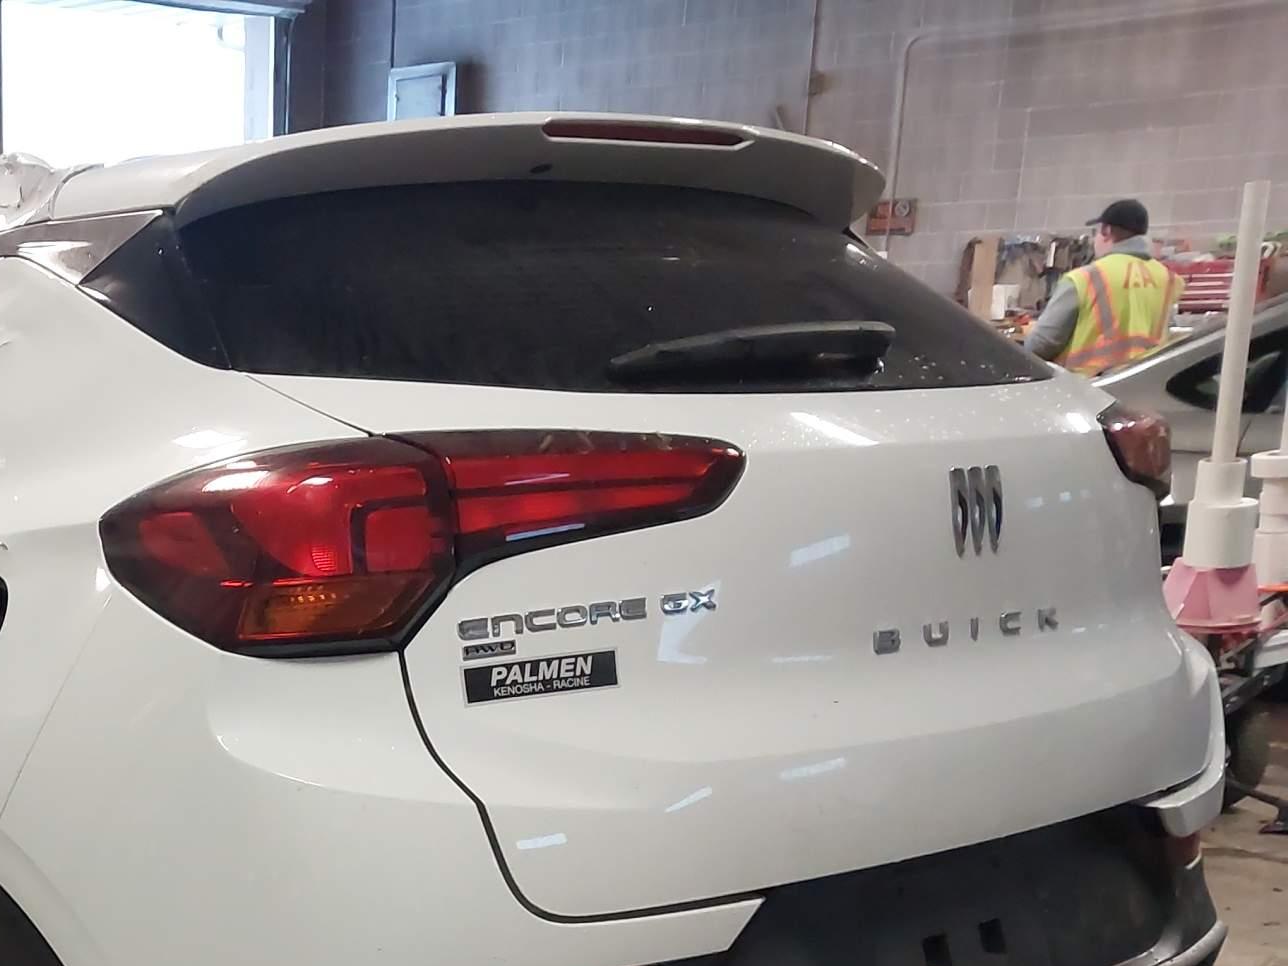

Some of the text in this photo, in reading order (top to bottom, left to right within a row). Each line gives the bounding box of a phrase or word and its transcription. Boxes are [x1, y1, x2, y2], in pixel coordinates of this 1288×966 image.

[457, 589, 717, 640] ENCORE GX
[873, 607, 1059, 656] BUICK
[491, 655, 593, 686] PALMEN
[494, 683, 545, 697] KENOSHA
[554, 676, 590, 688] RACINE
